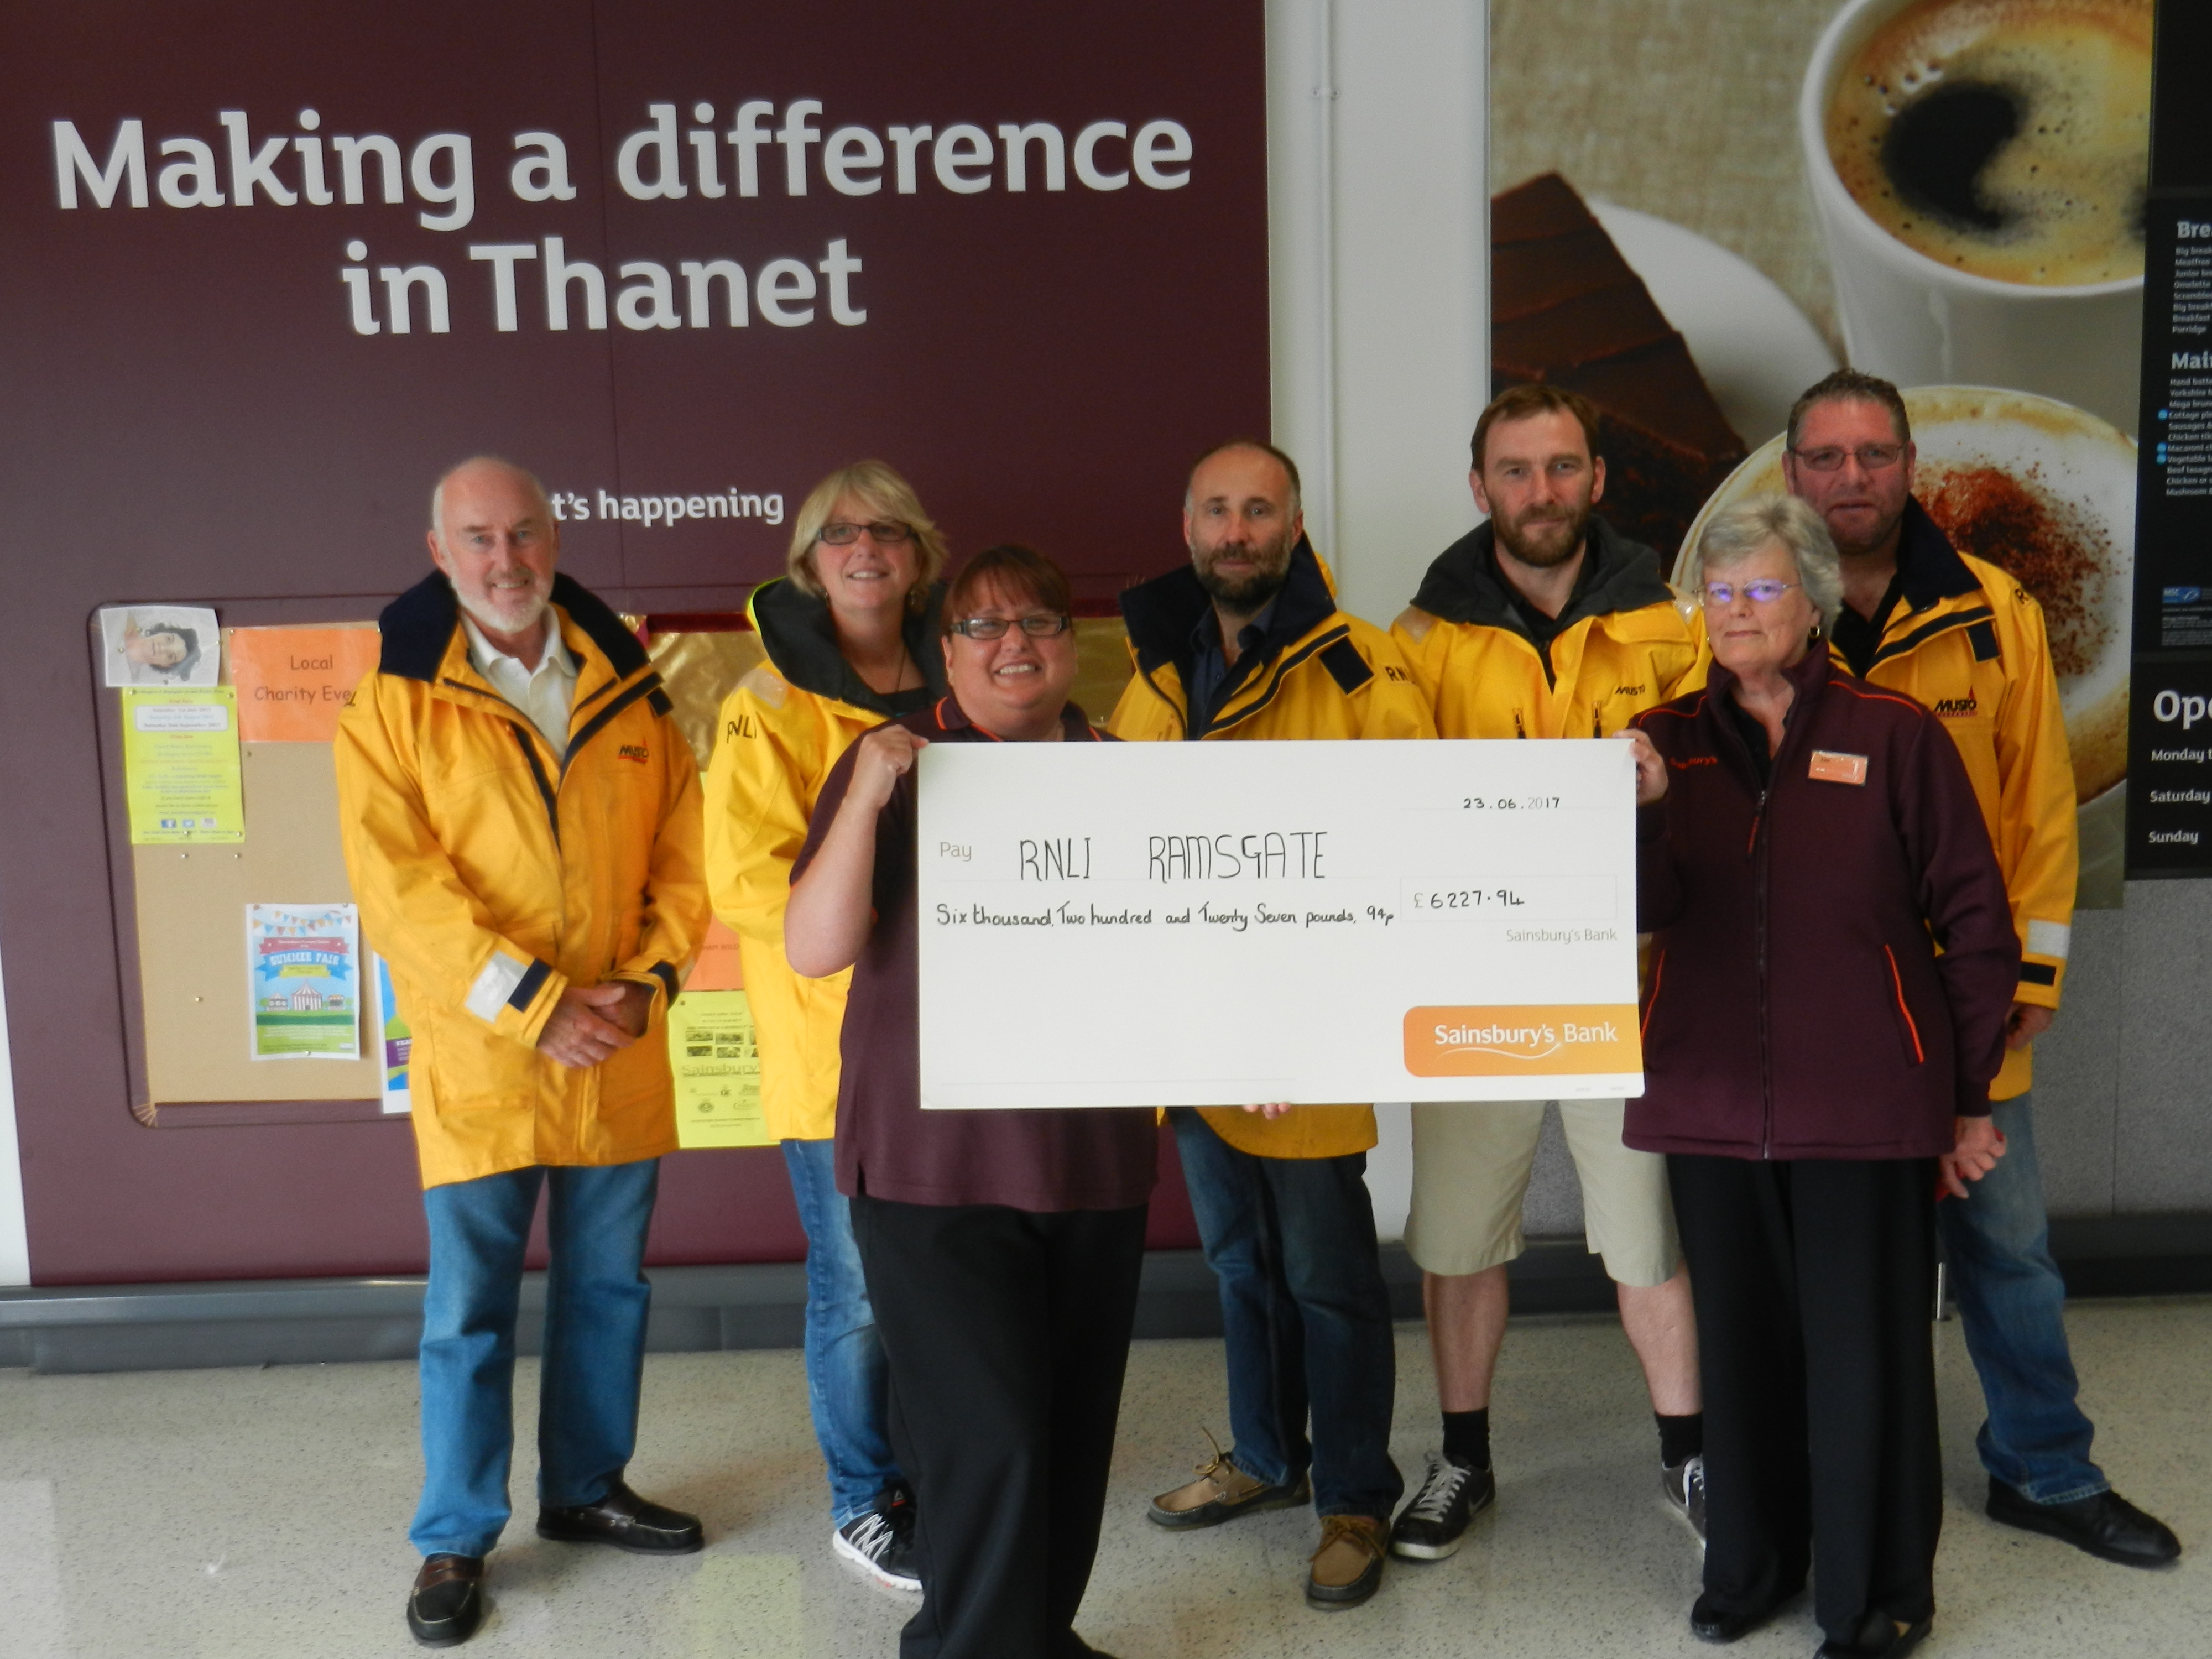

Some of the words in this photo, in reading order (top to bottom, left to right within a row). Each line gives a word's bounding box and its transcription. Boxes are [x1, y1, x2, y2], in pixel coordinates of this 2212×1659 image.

[53, 109, 475, 231] Making
[511, 131, 576, 202] a
[617, 100, 1193, 200] difference
[342, 241, 450, 335] in
[469, 238, 867, 332] Thanet
[2171, 350, 2212, 369] Mai
[599, 487, 784, 527] happening
[290, 654, 333, 670] Local
[254, 685, 316, 705] Charity
[322, 685, 352, 701] Eve
[2151, 748, 2205, 763] Monday
[2150, 789, 2210, 804] Saturday
[2148, 830, 2199, 845] Sunday
[940, 841, 972, 862] Pay
[1019, 837, 1091, 881] RNLI
[1149, 832, 1328, 883] RAMSGATE
[937, 904, 967, 925] Six
[1056, 901, 1086, 924] Two
[1091, 903, 1152, 926] hundred
[1165, 911, 1191, 924] and
[1198, 901, 1248, 932] Twenty
[1255, 903, 1297, 924] Seven
[1366, 905, 1394, 926] 94p
[1506, 928, 1580, 945] Sainsbury's
[1584, 927, 1618, 942] Bank
[1434, 1023, 1555, 1047] Sainsbury's
[1563, 1021, 1618, 1043] Bank
[682, 1063, 758, 1074] Sainsbury
